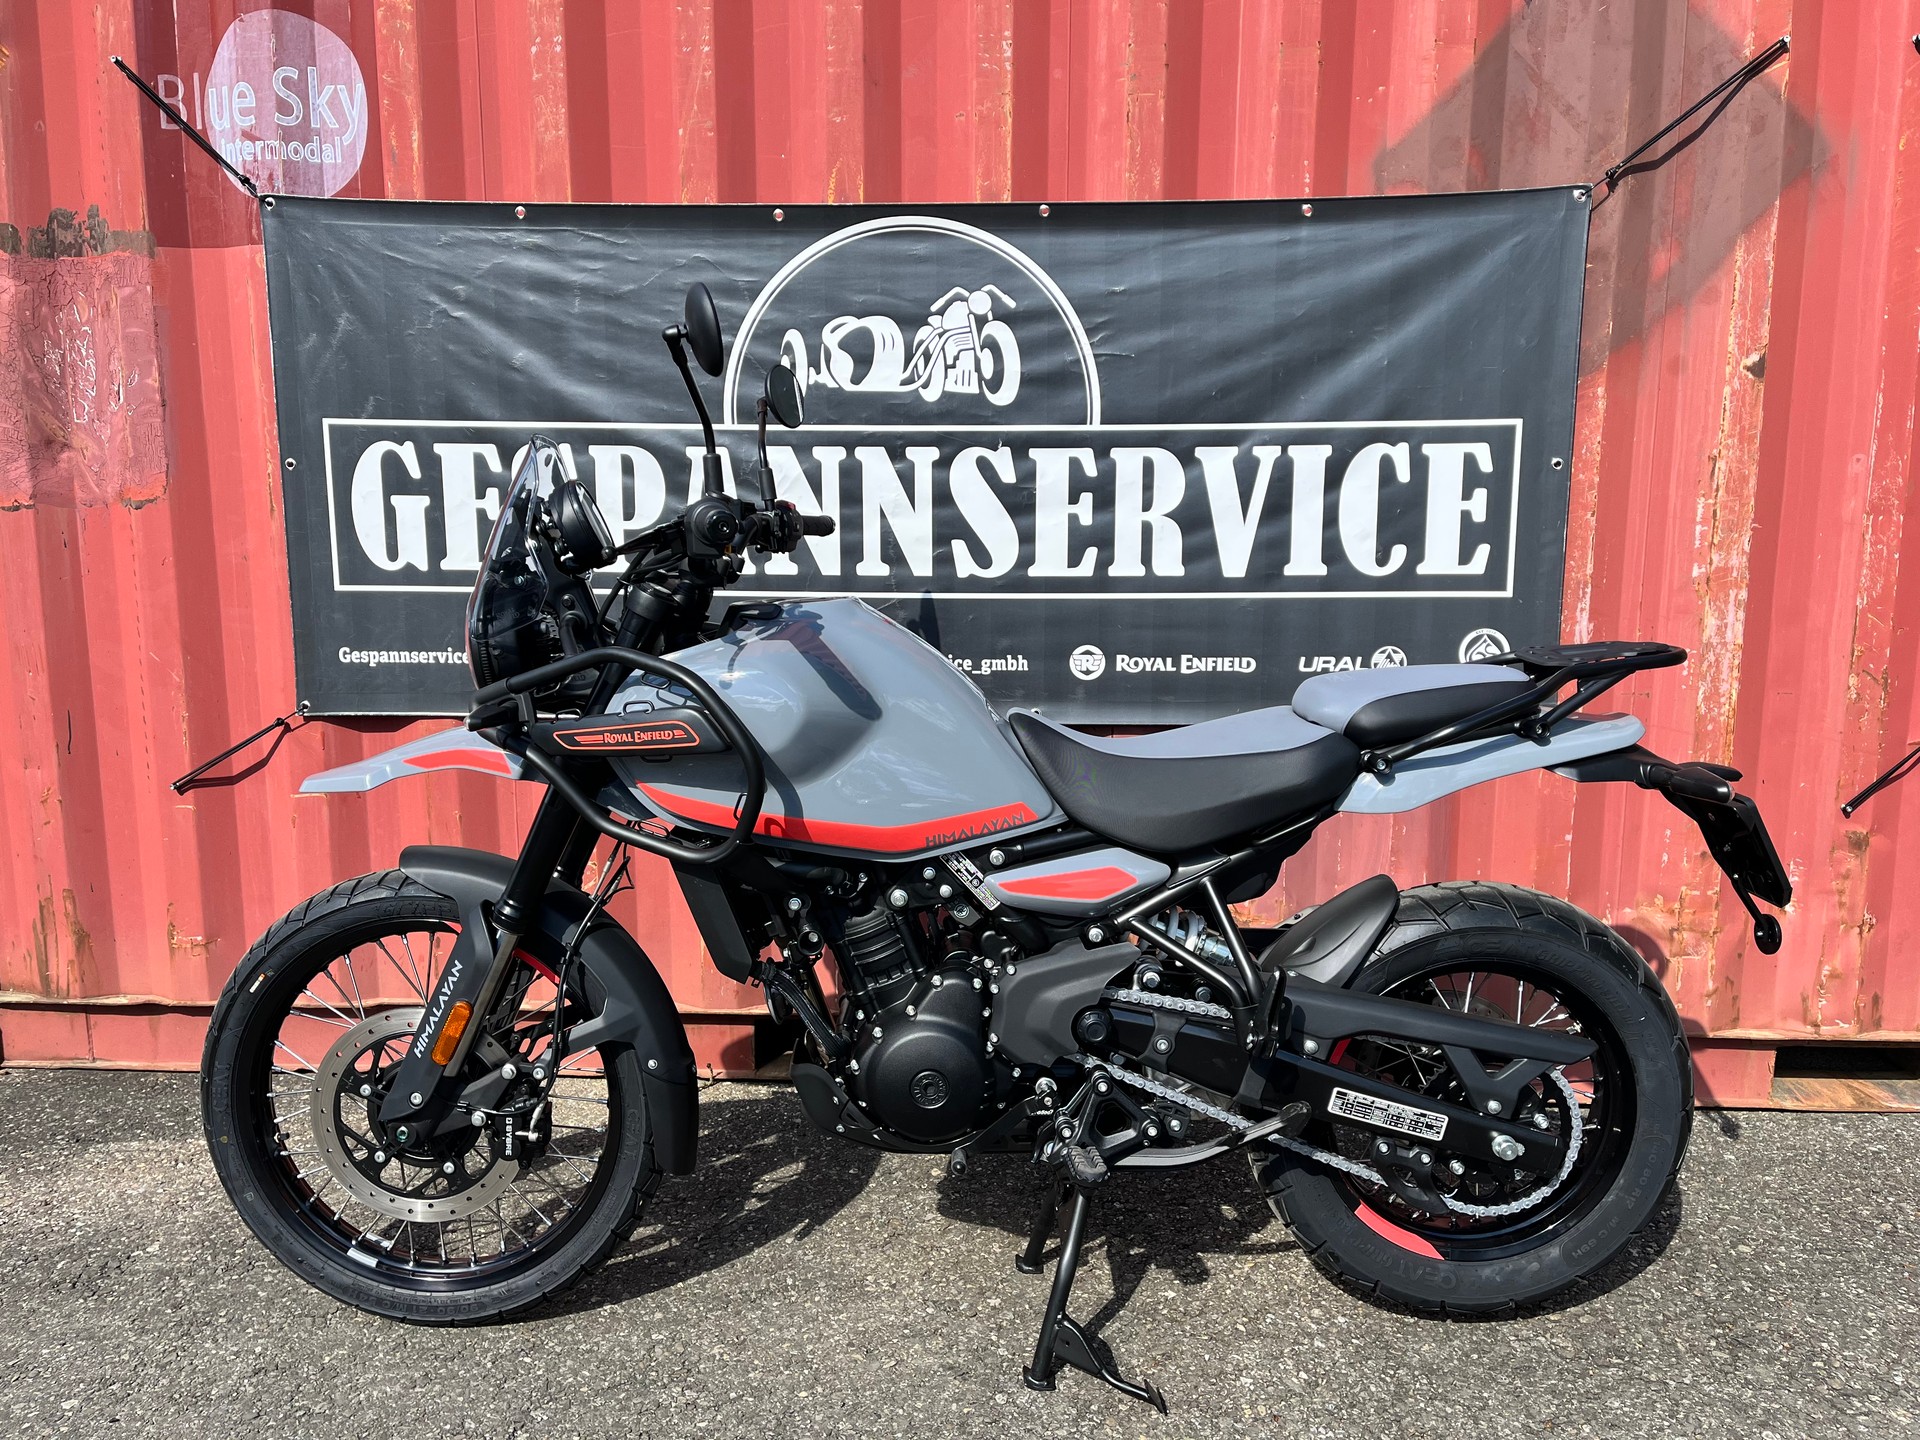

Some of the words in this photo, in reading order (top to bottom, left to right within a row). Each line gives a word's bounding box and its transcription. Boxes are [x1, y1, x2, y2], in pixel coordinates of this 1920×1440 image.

[157, 72, 256, 130] Blue
[272, 66, 362, 145] Sky
[1116, 654, 1177, 673] ROYAL
[1180, 654, 1256, 674] ENFIELD
[1299, 656, 1369, 672] URAL
[603, 731, 633, 744] ROYAL
[634, 729, 674, 743] ENFIELD
[925, 811, 1025, 848] HIMALAYAN
[413, 959, 463, 1059] HIMALAYAN
